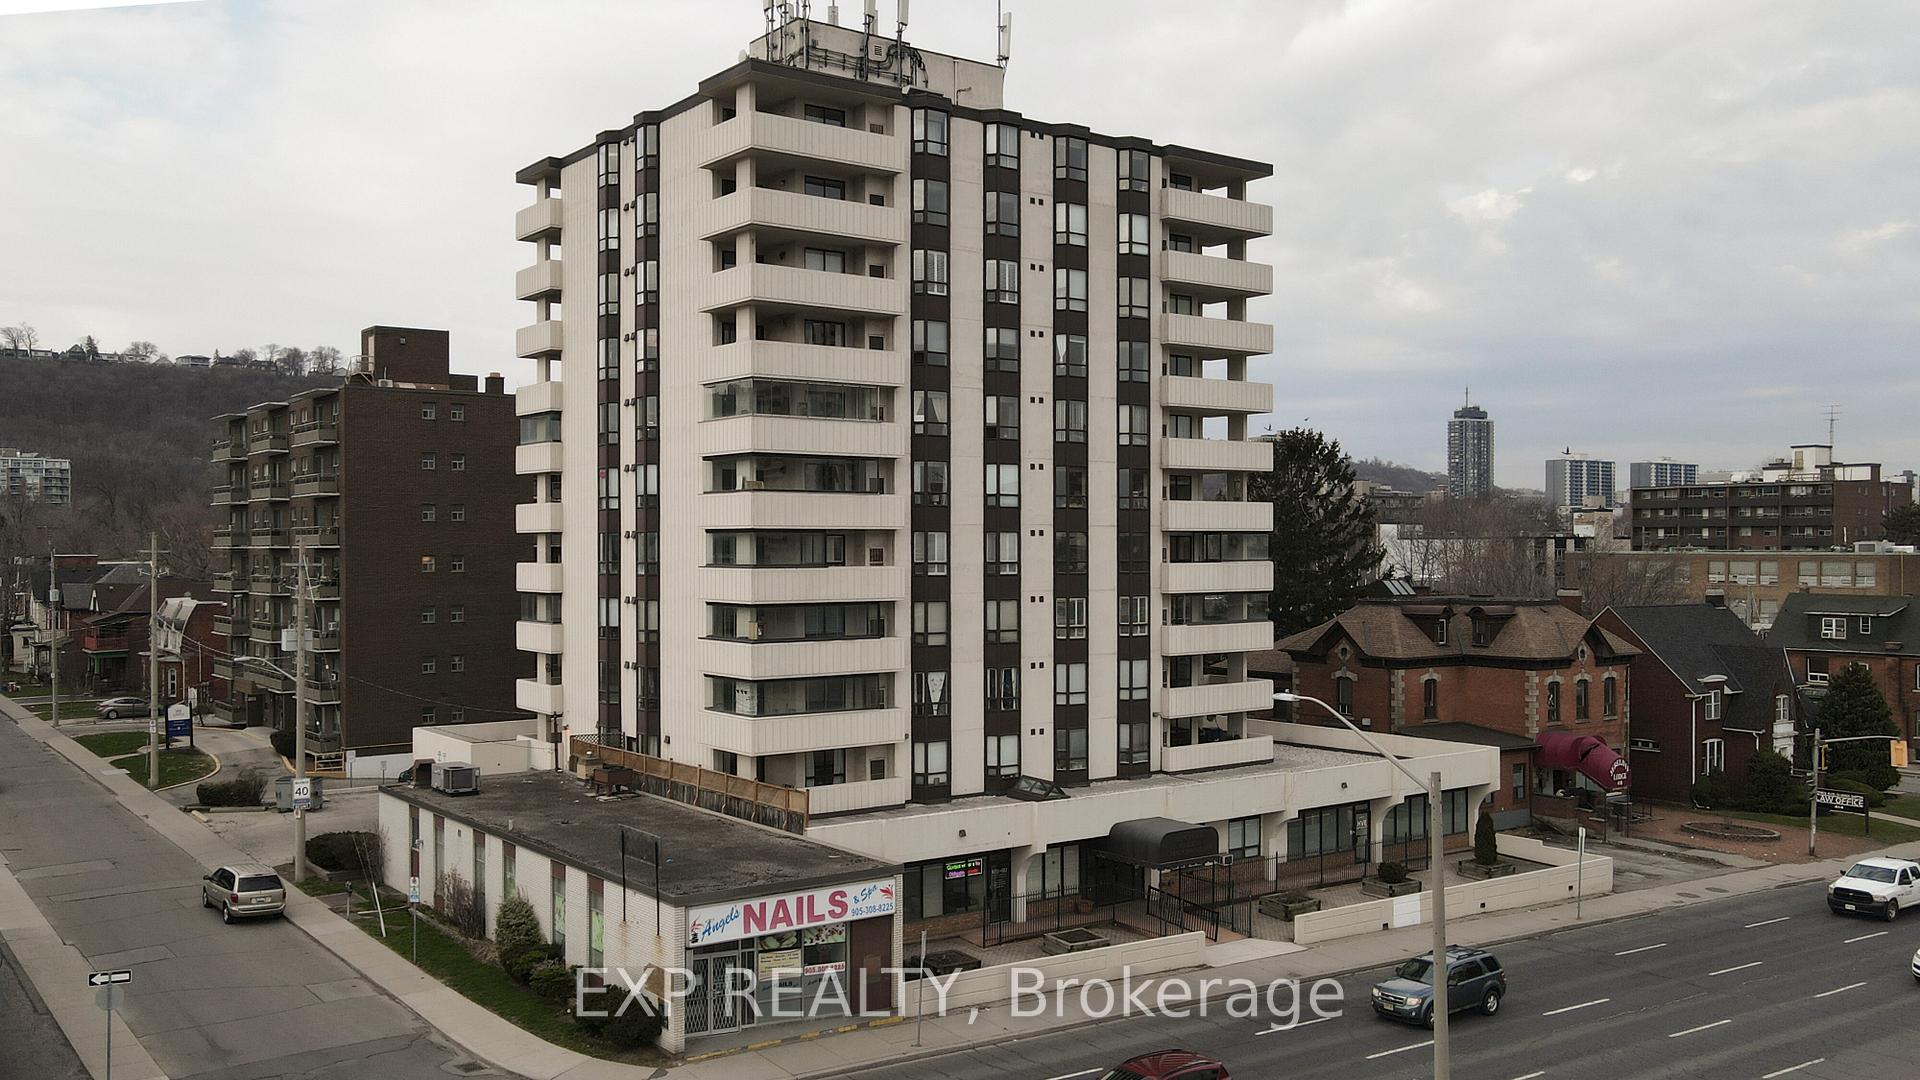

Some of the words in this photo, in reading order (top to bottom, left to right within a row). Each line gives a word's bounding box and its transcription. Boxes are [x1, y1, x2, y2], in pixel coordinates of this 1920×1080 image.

[295, 786, 309, 796] 40
[1816, 794, 1834, 803] LAW
[1835, 796, 1864, 808] OFFICE
[701, 905, 740, 942] Angel's
[743, 890, 848, 934] NAILS
[853, 895, 859, 904] &
[860, 884, 878, 901] Spa
[851, 902, 894, 917] 905-308-8225
